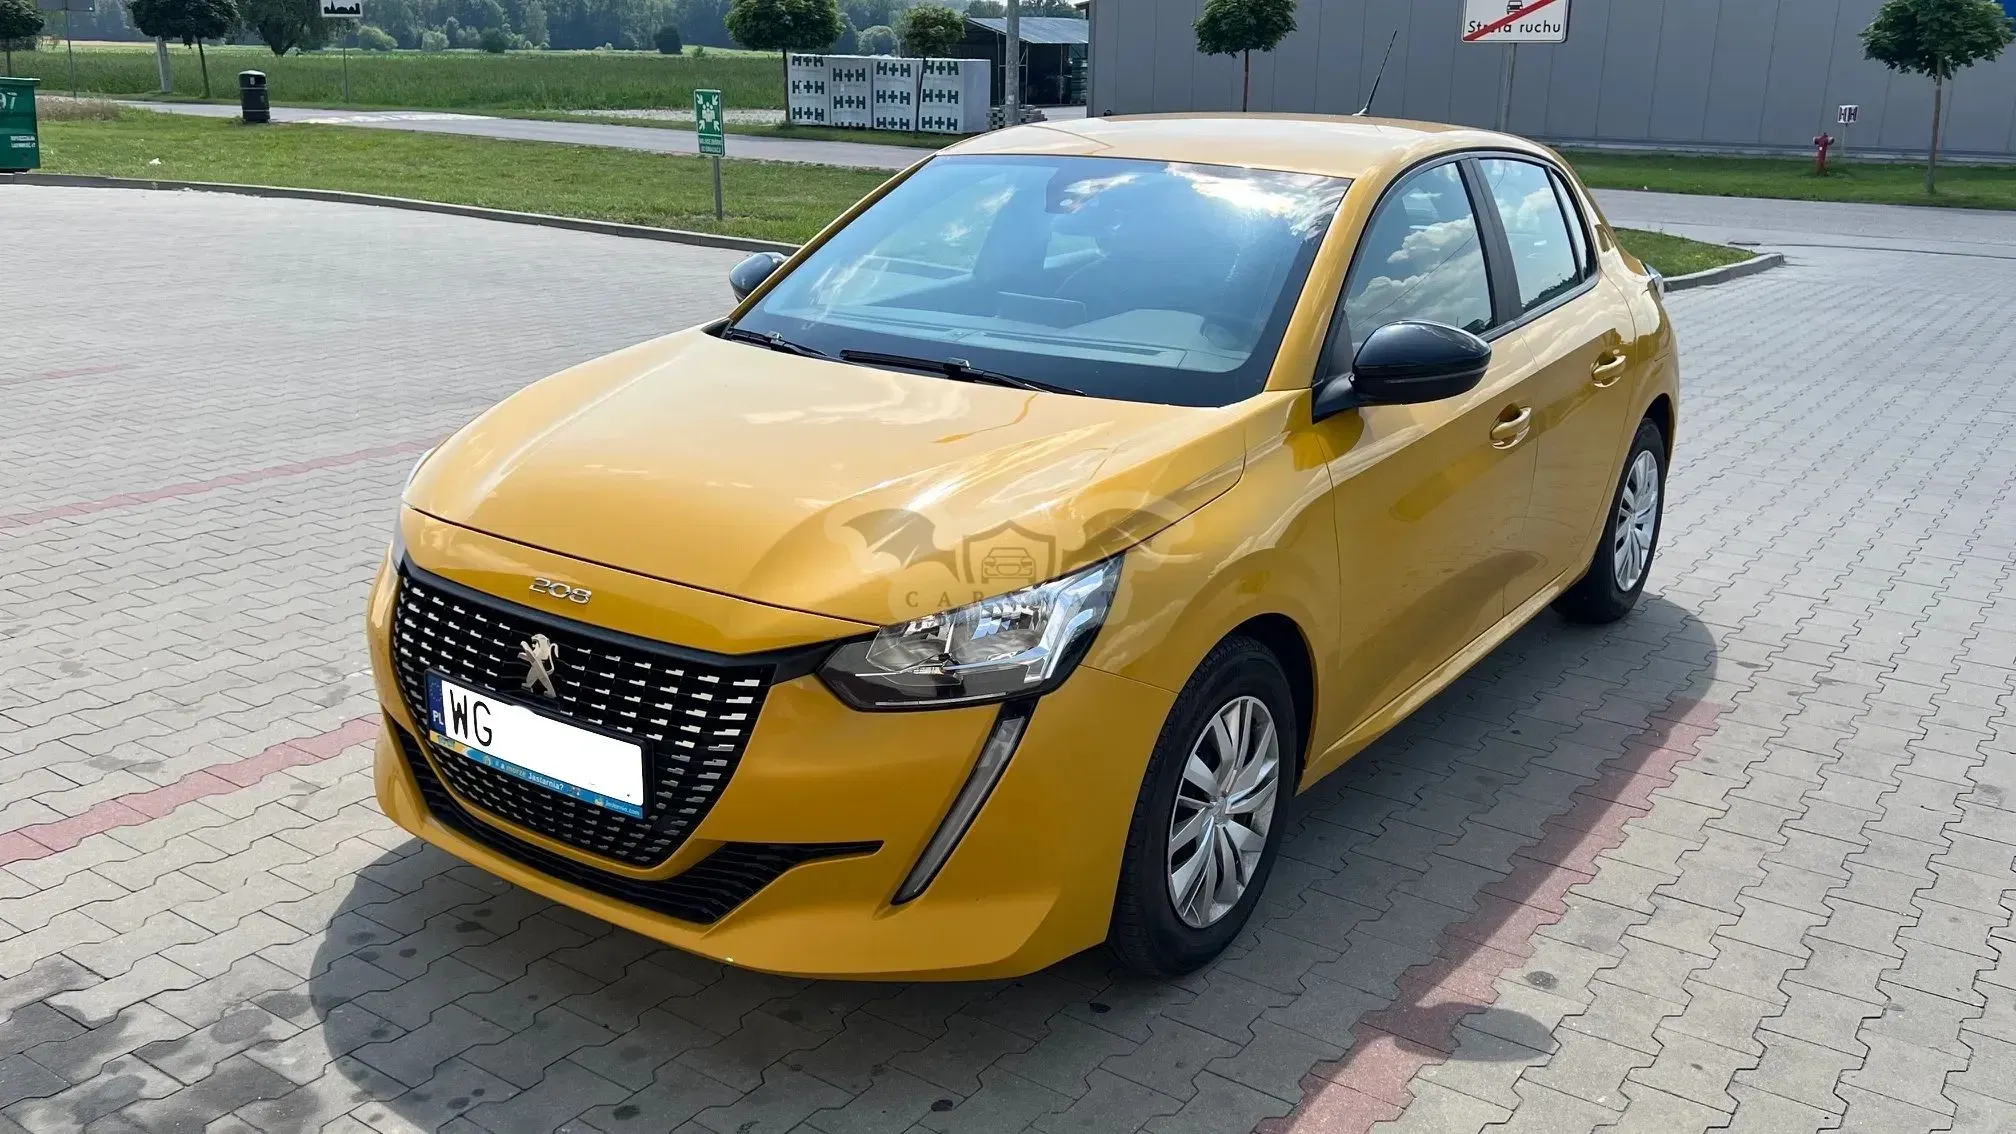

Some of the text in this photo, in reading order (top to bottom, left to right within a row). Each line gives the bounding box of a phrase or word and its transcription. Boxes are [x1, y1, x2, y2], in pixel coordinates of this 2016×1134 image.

[1468, 20, 1561, 33] Stra ruchu
[833, 68, 866, 82] H+H
[876, 61, 911, 78] H+H
[923, 61, 959, 76] H+H
[792, 80, 825, 95] H+H
[833, 95, 866, 110] H+H
[876, 89, 911, 106] H+H
[921, 88, 959, 105] H+H
[792, 106, 825, 122] H+H
[876, 116, 910, 130] H+H
[921, 116, 958, 131] H+H
[528, 577, 592, 604] 208
[432, 709, 444, 726] PL
[449, 688, 493, 747] WG
[527, 771, 565, 792] Jastarnia?
